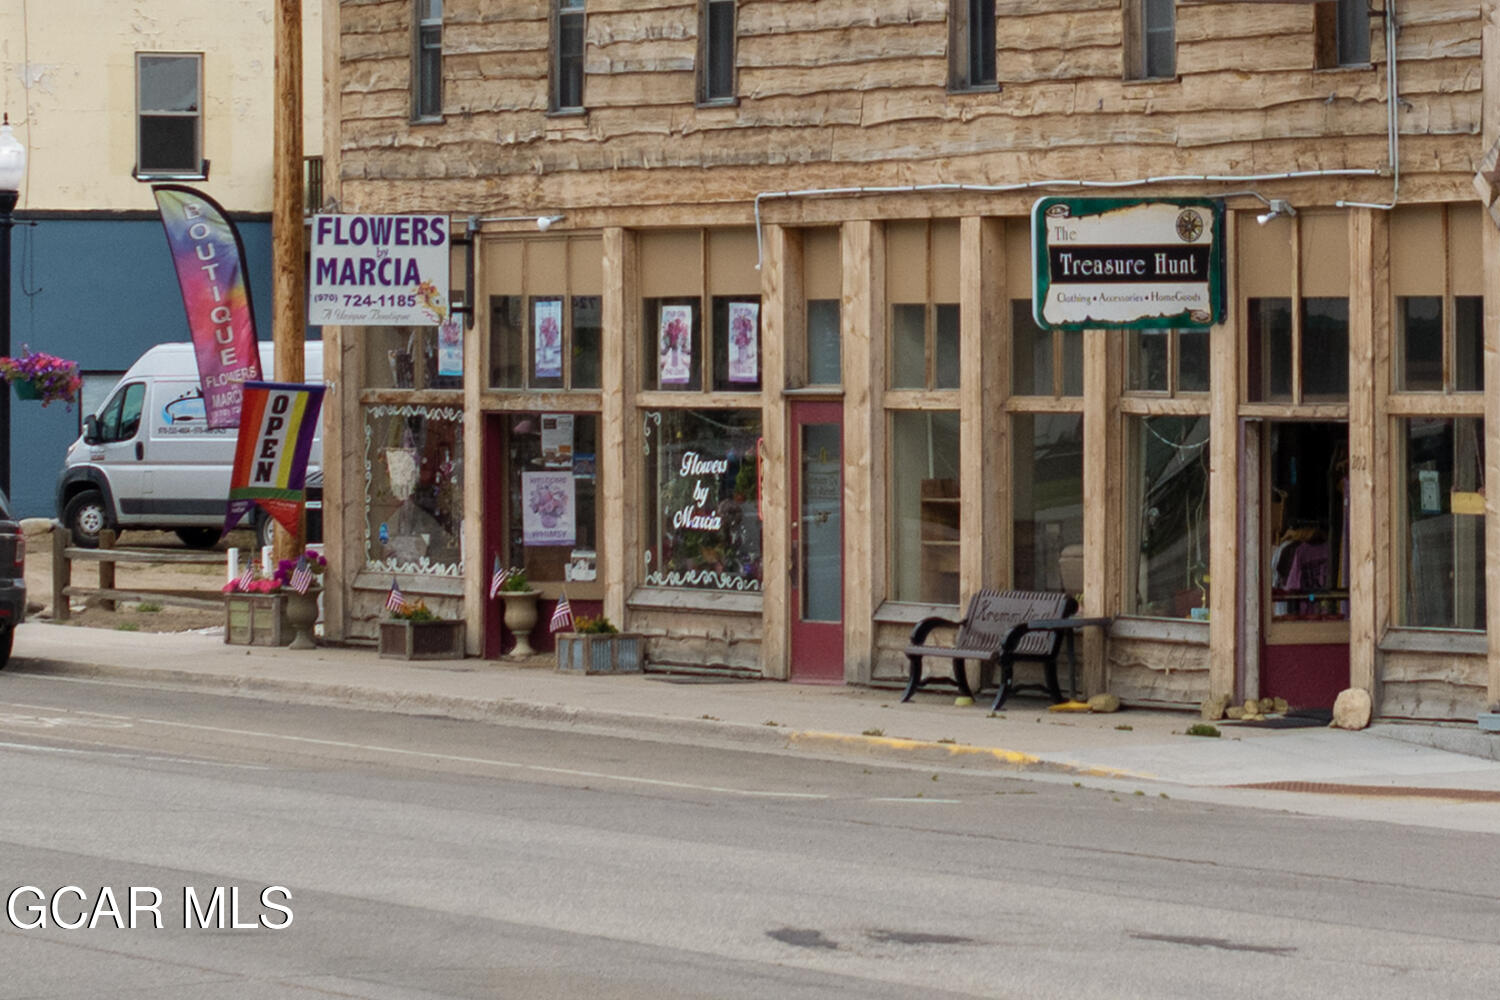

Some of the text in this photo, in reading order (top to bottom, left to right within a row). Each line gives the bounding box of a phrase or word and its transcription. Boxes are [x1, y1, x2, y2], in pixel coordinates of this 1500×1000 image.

[317, 216, 446, 246] FLOWERS
[1054, 226, 1077, 241] The
[376, 247, 389, 258] by
[1060, 252, 1198, 276] Treasure Hunt
[316, 257, 421, 286] MARCIA
[184, 203, 238, 366] BOUTIQUE
[314, 294, 417, 307] (970) 724-1185
[1057, 292, 1091, 304] Clothing
[1099, 292, 1144, 302] Accessories
[206, 366, 257, 389] FLOWERS
[212, 390, 243, 408] MARCI
[254, 395, 289, 482] OPEN
[680, 451, 728, 477] Flowers
[693, 480, 709, 508] by
[673, 504, 721, 530] Marcia
